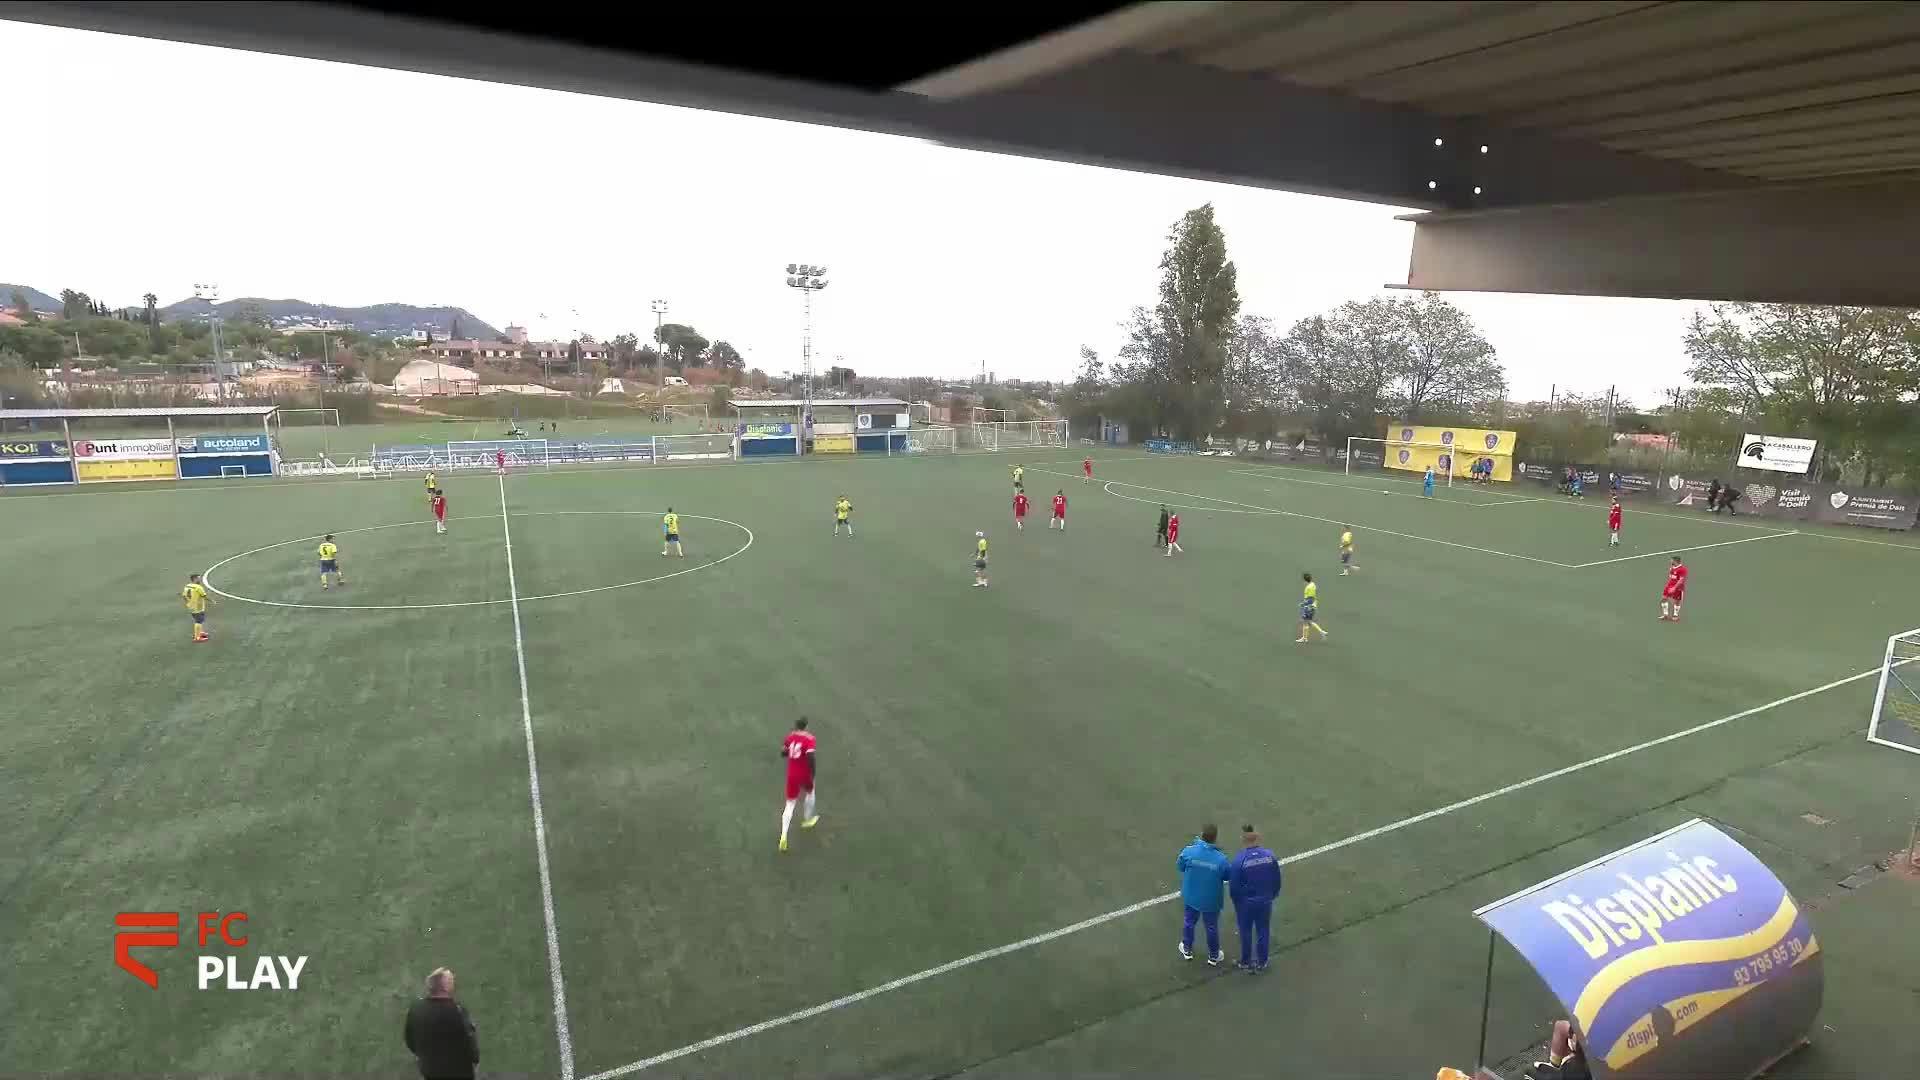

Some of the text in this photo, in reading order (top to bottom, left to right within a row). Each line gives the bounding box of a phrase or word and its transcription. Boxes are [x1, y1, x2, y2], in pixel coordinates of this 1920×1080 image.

[85, 443, 118, 453] Punt
[203, 436, 260, 448] autoland
[1541, 850, 1737, 960] Displanic
[1734, 937, 1803, 986] 93 795 95 30
